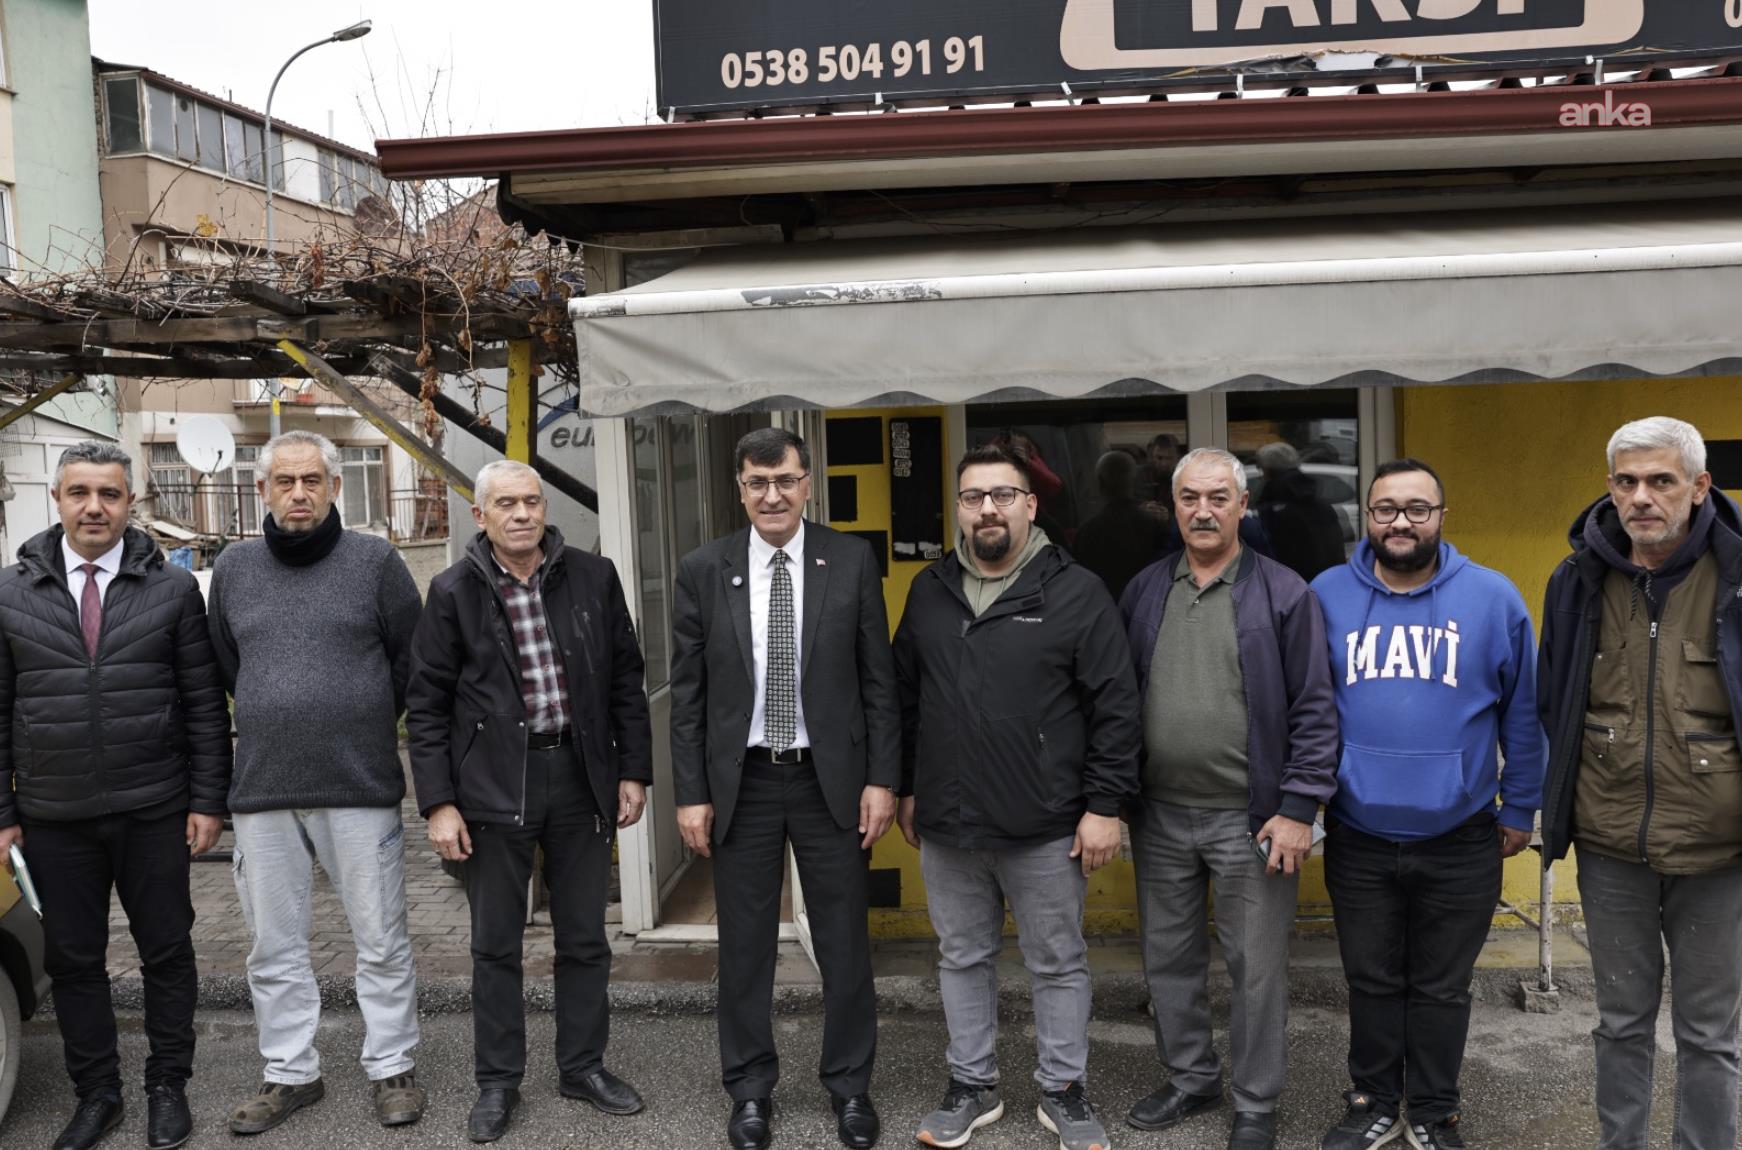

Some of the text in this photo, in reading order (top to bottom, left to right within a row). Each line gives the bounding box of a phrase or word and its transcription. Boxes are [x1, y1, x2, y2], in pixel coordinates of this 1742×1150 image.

[721, 35, 984, 89] 0538 504 91 91
